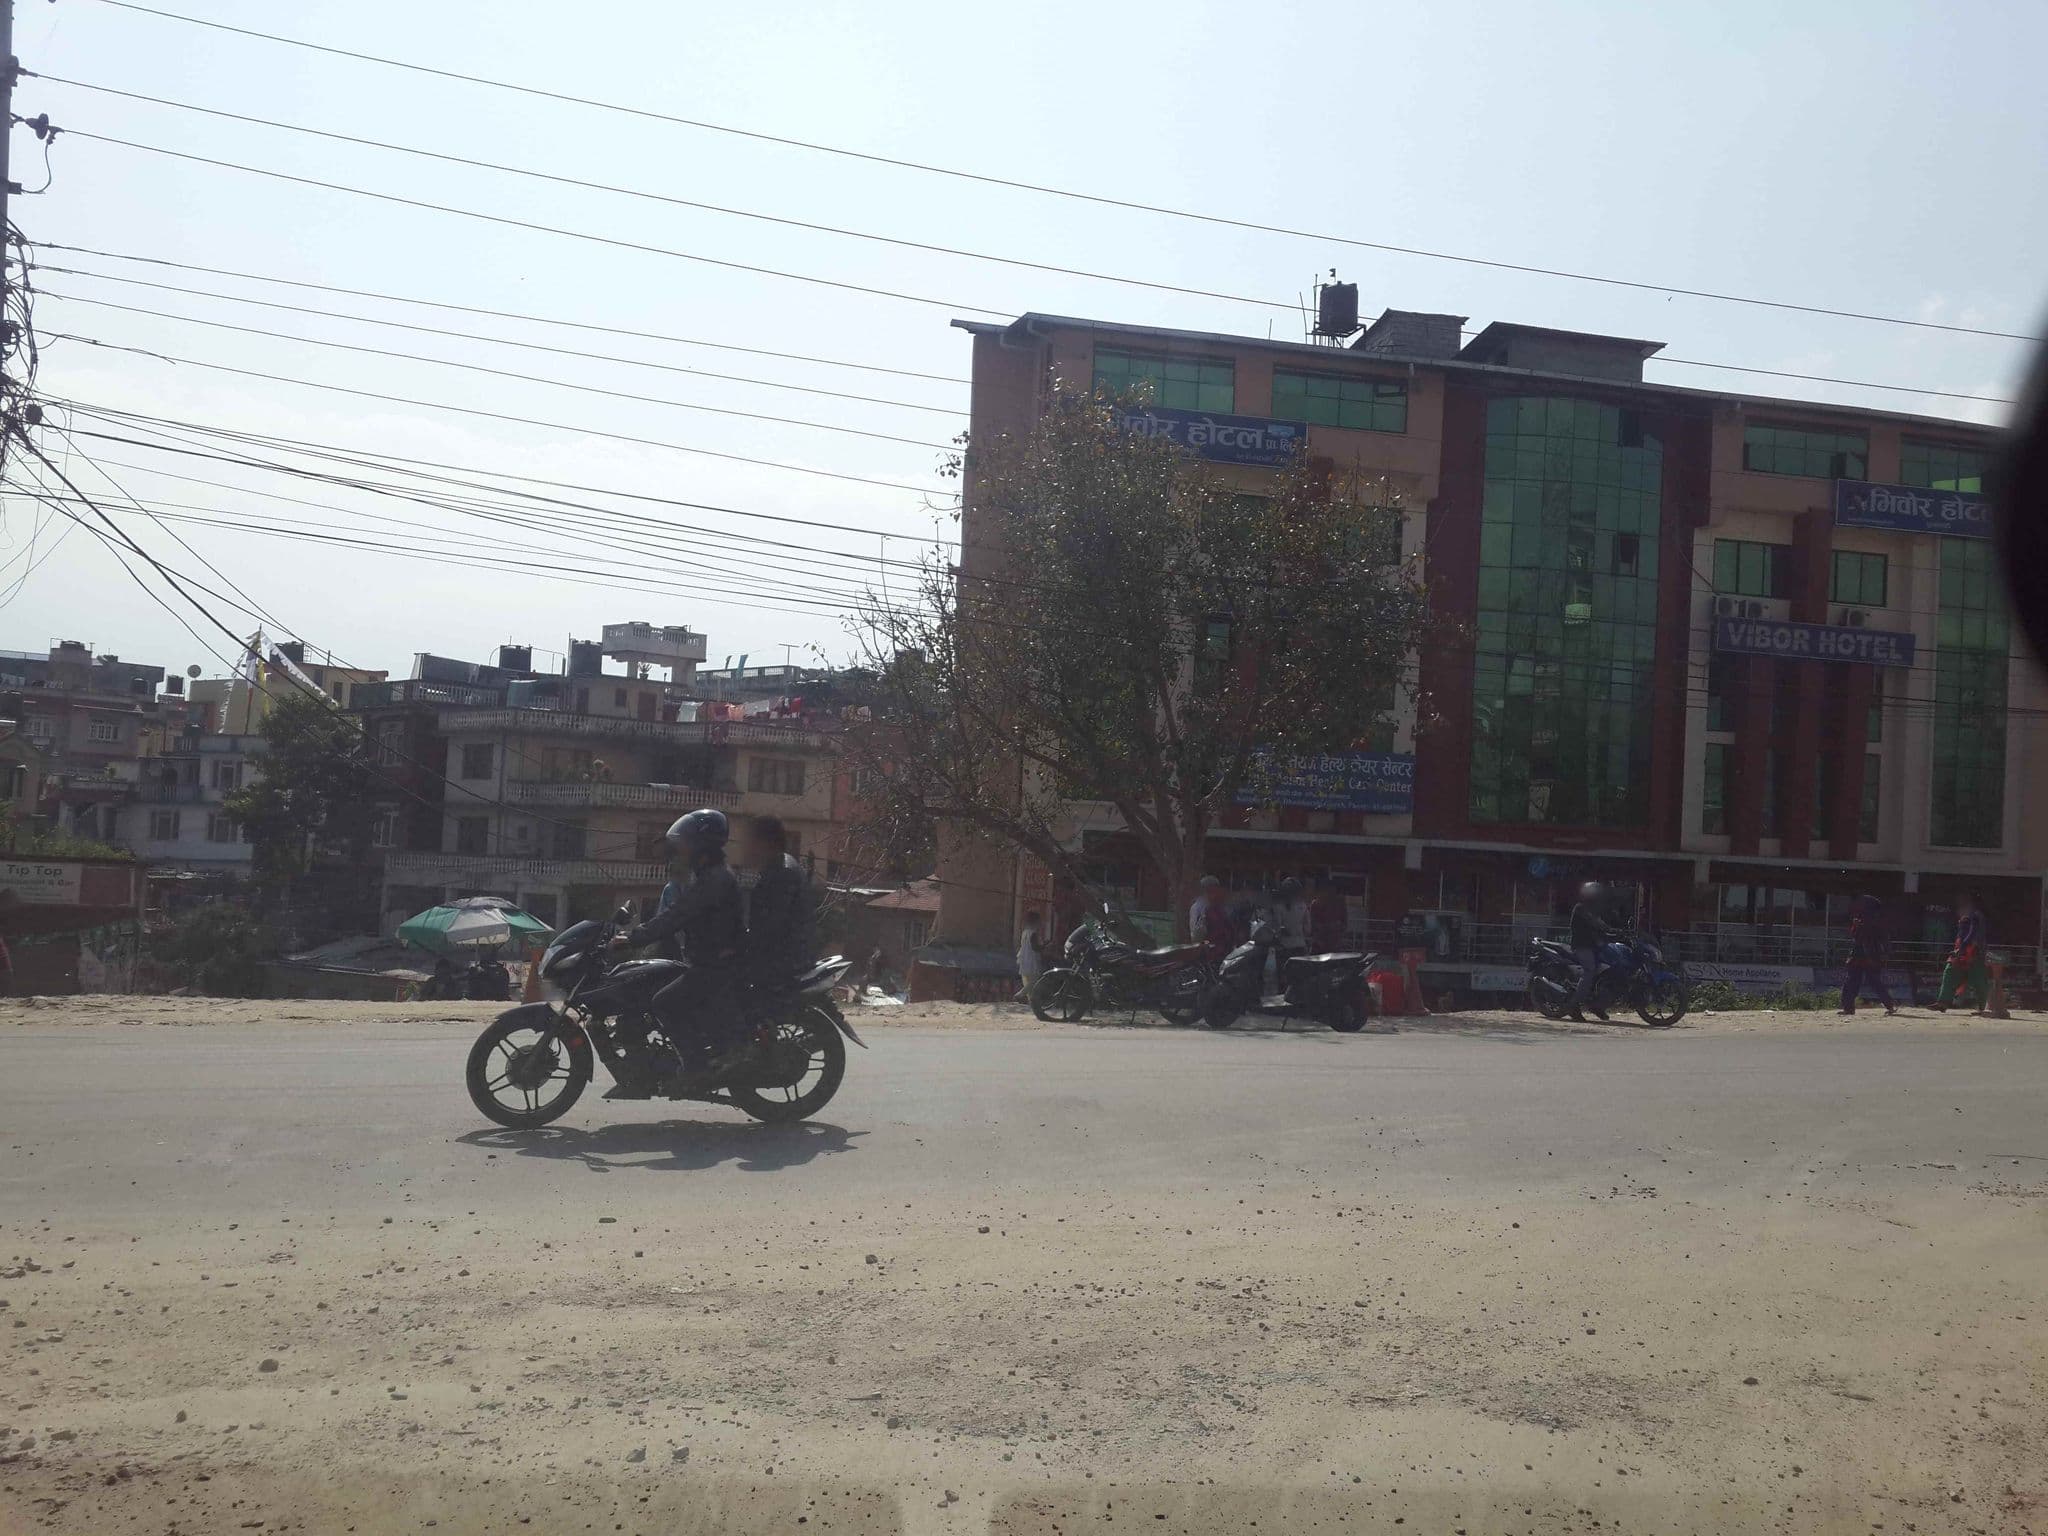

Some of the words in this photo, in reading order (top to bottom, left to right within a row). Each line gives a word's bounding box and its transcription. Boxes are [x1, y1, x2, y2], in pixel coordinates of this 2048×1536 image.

[1187, 417, 1265, 450] होटल
[1727, 622, 1809, 652] VIBOR
[1819, 631, 1902, 660] HOTEL
[1381, 757, 1414, 777] सेन्टर
[6, 864, 30, 877] Tip
[33, 865, 63, 877] Top
